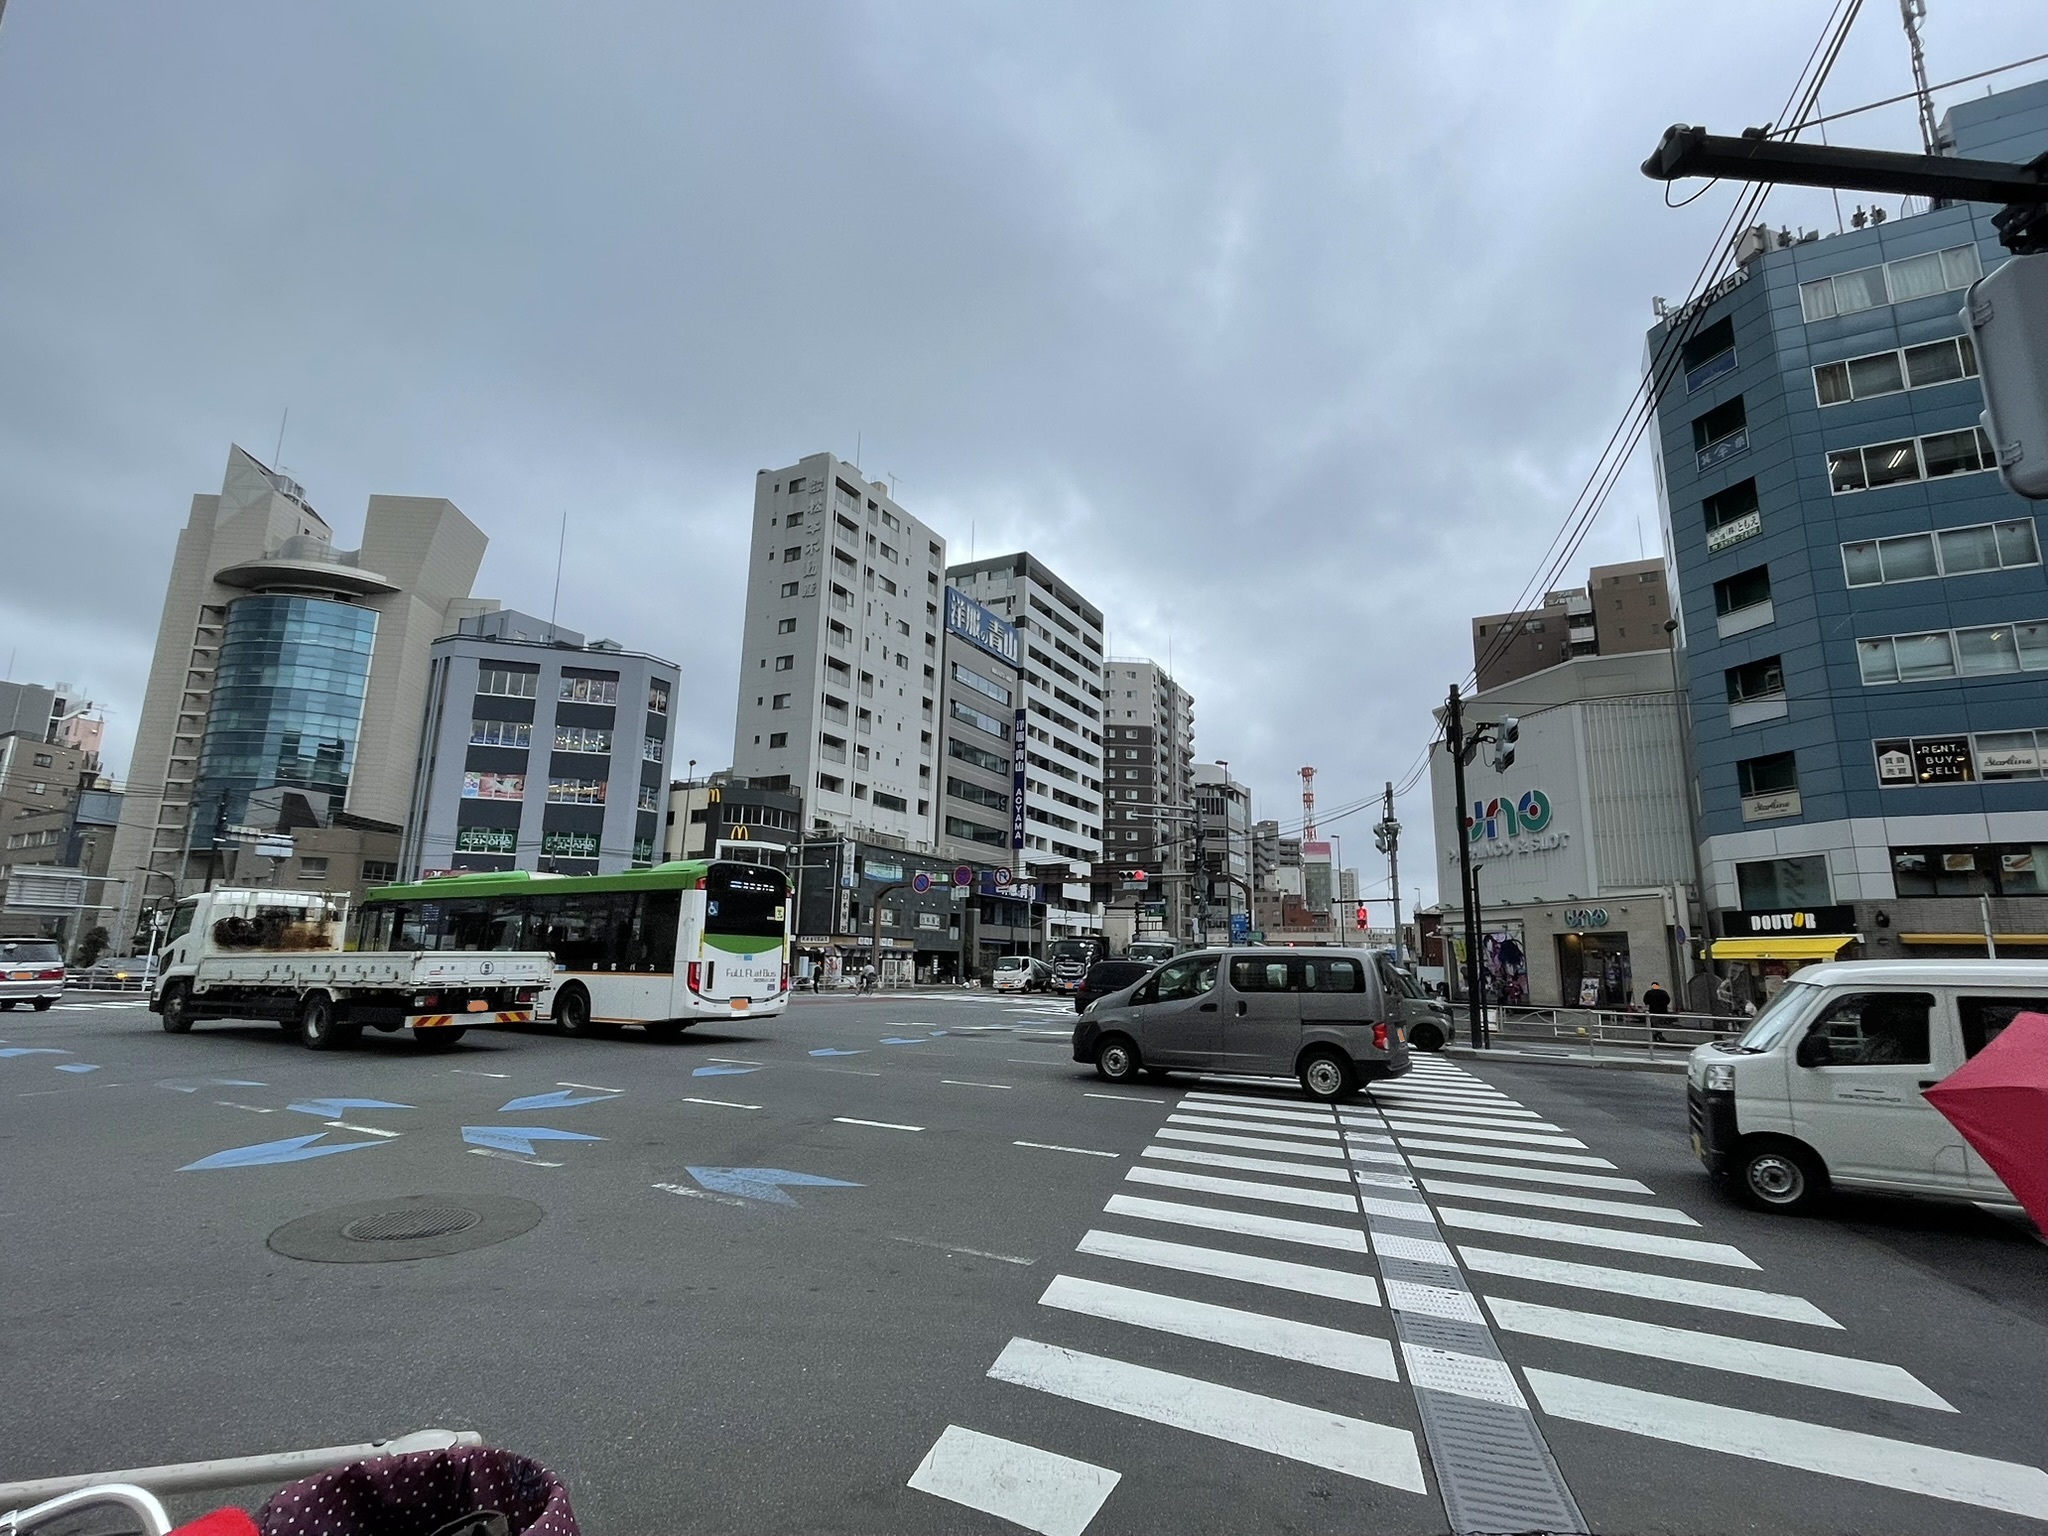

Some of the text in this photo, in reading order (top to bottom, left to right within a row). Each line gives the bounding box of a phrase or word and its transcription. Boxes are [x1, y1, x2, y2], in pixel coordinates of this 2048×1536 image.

[951, 592, 1018, 663] 洋服の青山
[1015, 720, 1025, 772] 洋服の青山
[1927, 766, 1960, 775] SELL
[1014, 788, 1023, 839] AOYAMA
[1531, 833, 1570, 853] SLOT
[1750, 912, 1817, 931] DOUTOR
